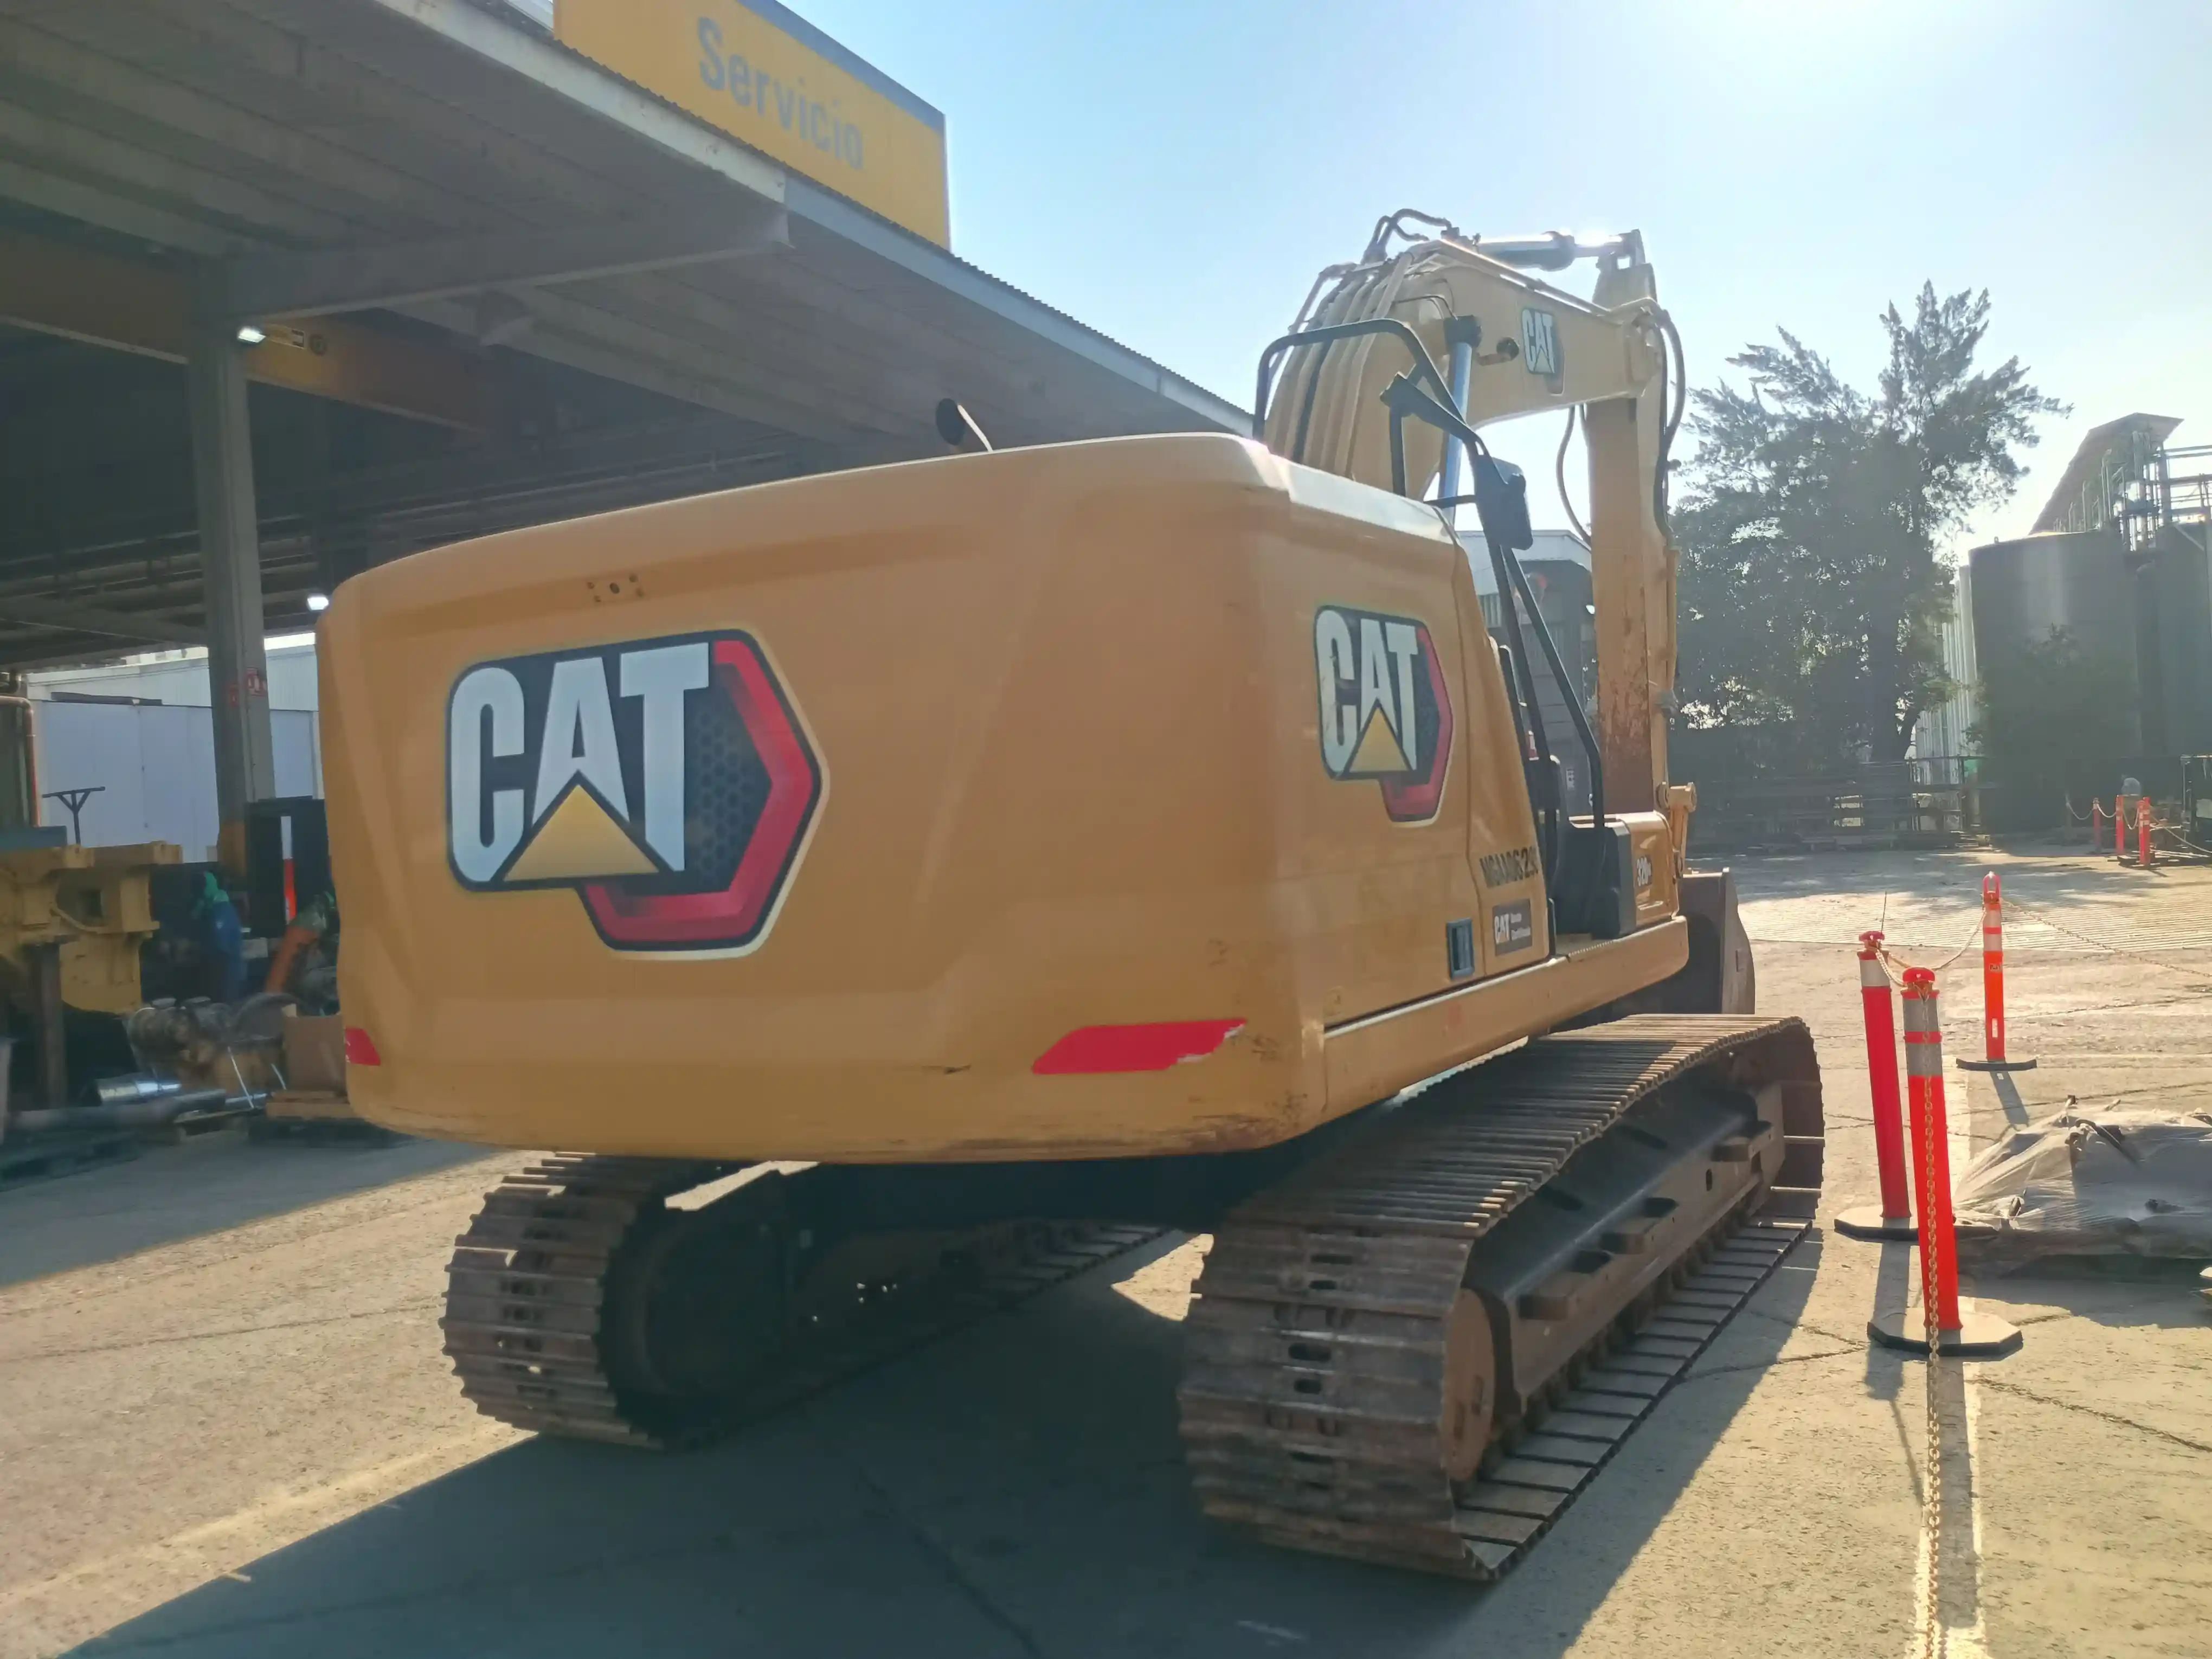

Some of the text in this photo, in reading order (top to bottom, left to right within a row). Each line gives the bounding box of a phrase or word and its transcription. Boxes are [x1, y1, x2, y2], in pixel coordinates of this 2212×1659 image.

[697, 16, 863, 169] Servicio
[1522, 309, 1555, 374] CAT
[451, 642, 709, 883] CAT
[1316, 609, 1419, 773] CAT
